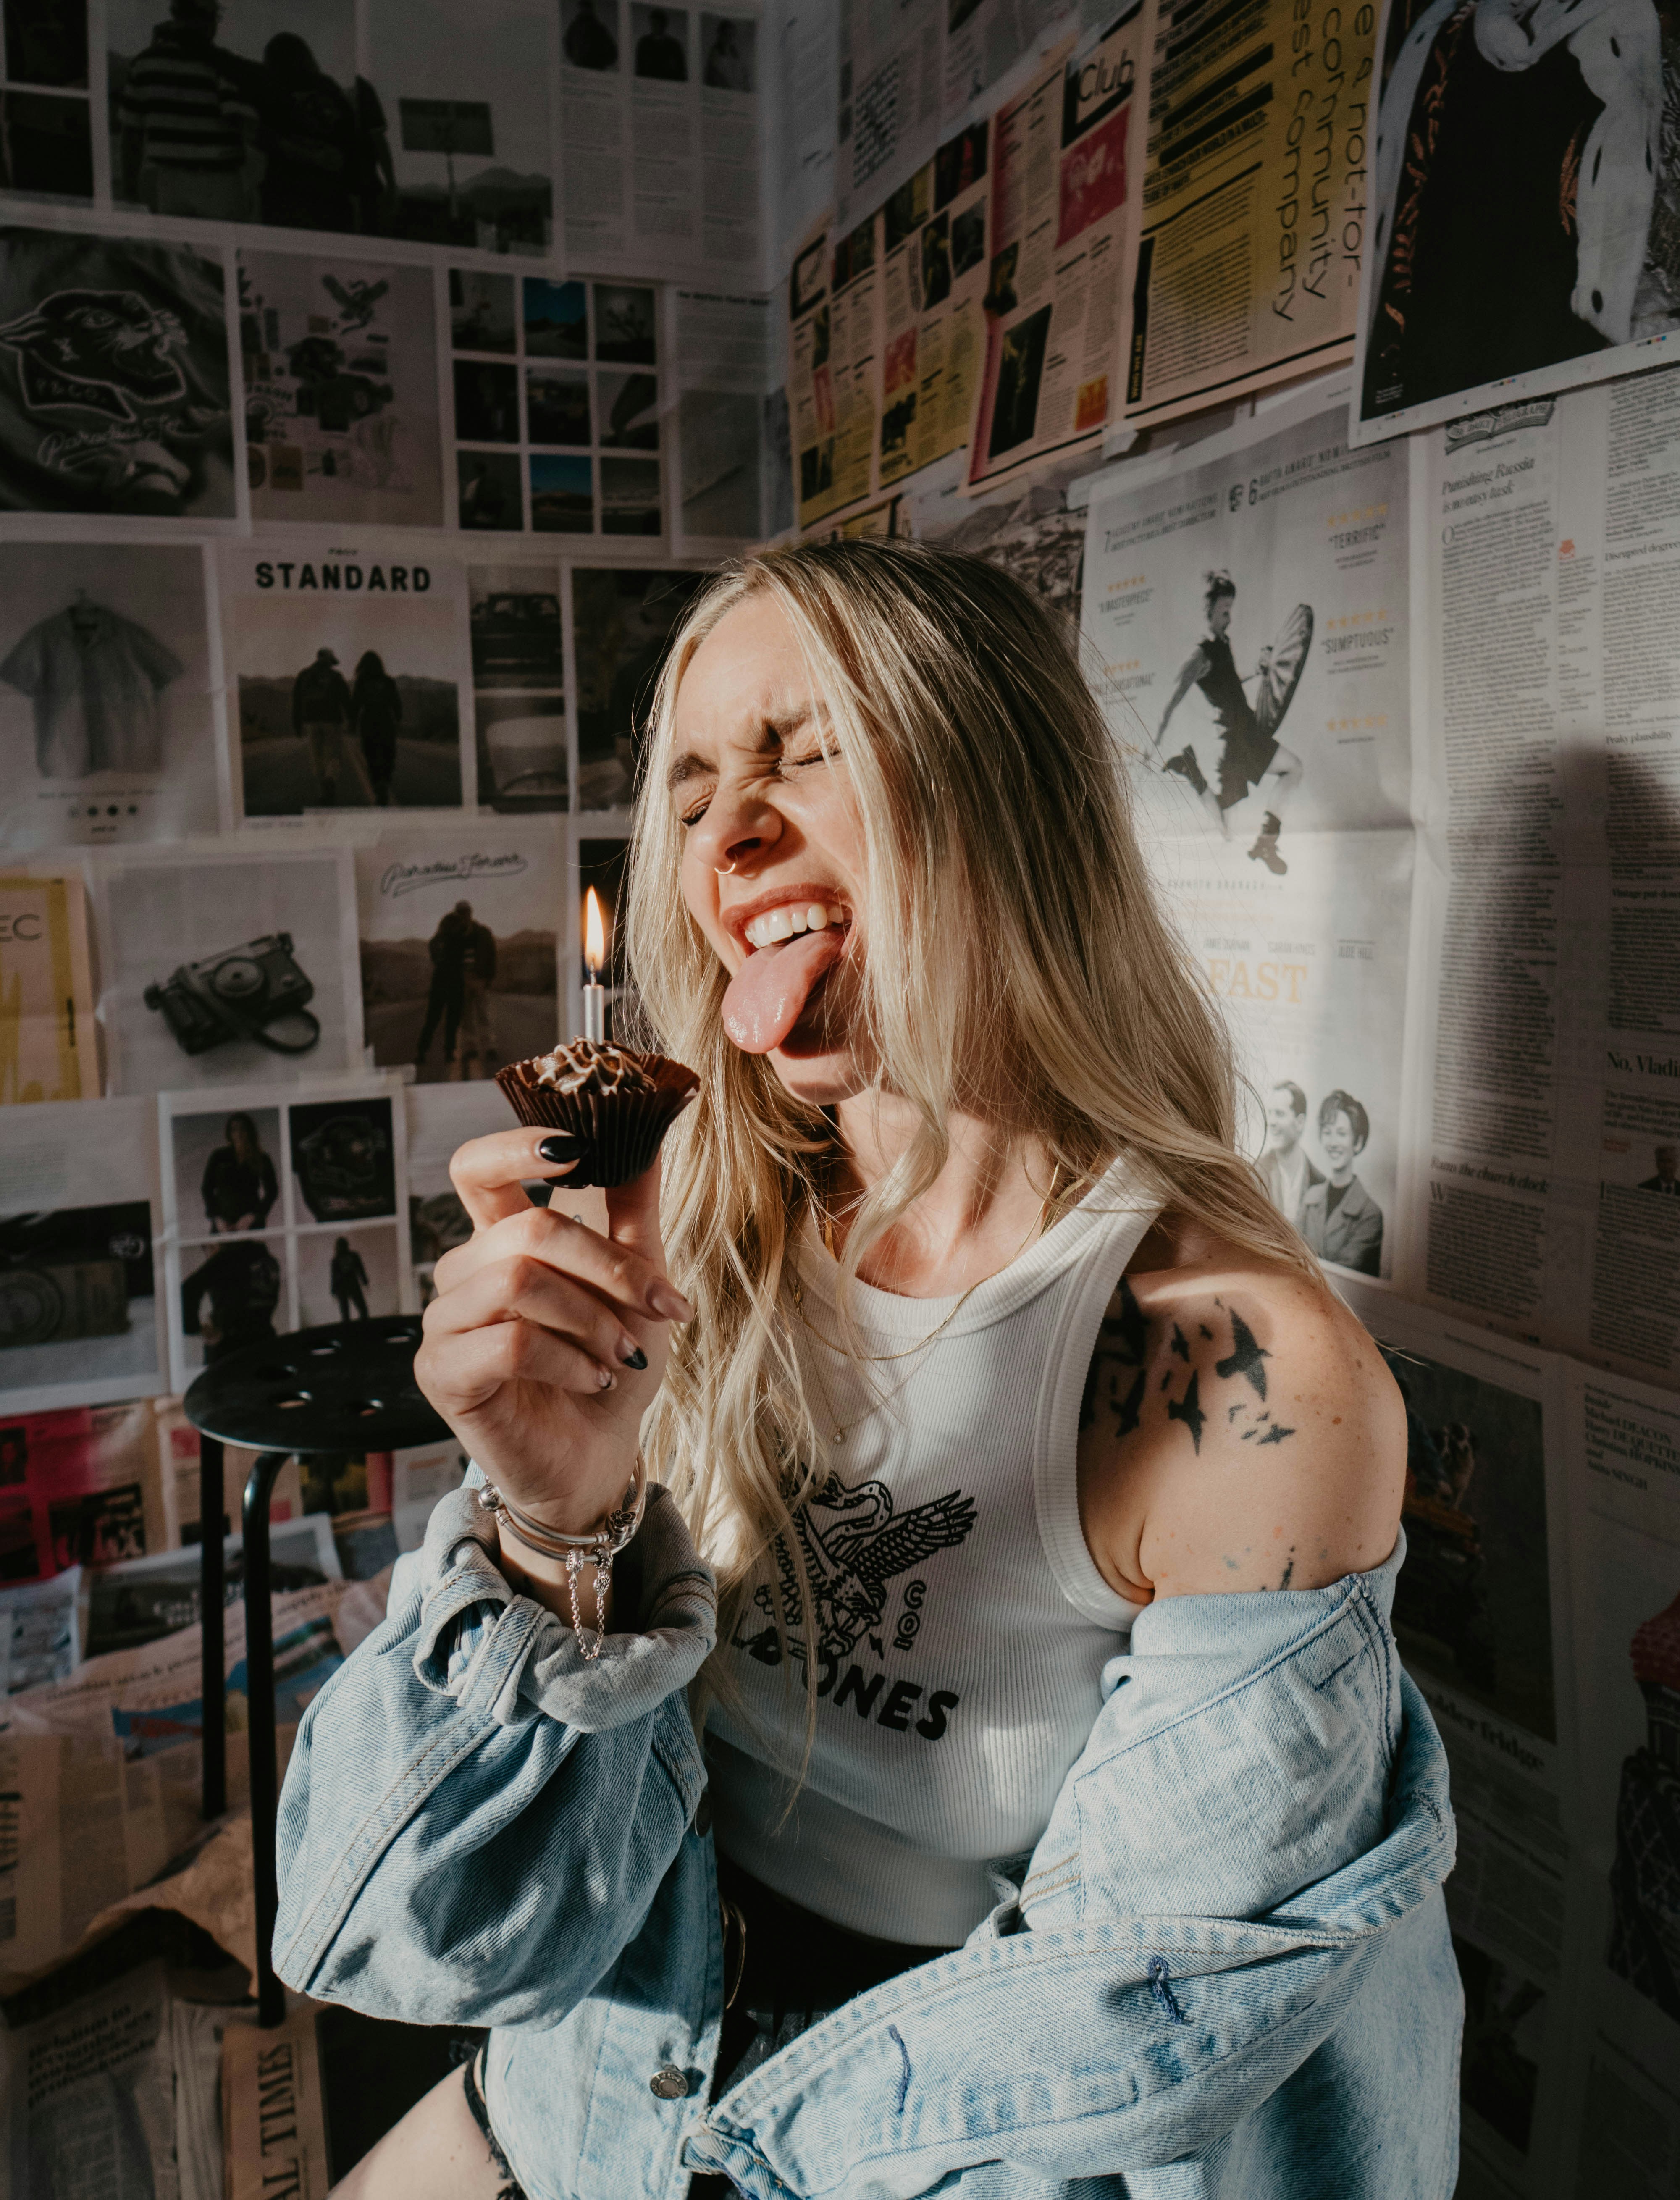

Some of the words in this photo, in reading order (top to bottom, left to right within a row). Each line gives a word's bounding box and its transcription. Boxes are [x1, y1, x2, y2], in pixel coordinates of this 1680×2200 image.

[1079, 49, 1135, 102] Club
[1301, 7, 1347, 299] community
[1272, 88, 1314, 322] company
[1495, 456, 1536, 479] Russia
[1249, 478, 1258, 506] 6
[255, 562, 431, 592] STANDARD
[1193, 958, 1308, 1005] FAST
[1608, 1051, 1633, 1073] No,
[257, 2040, 298, 2159] TIMES
